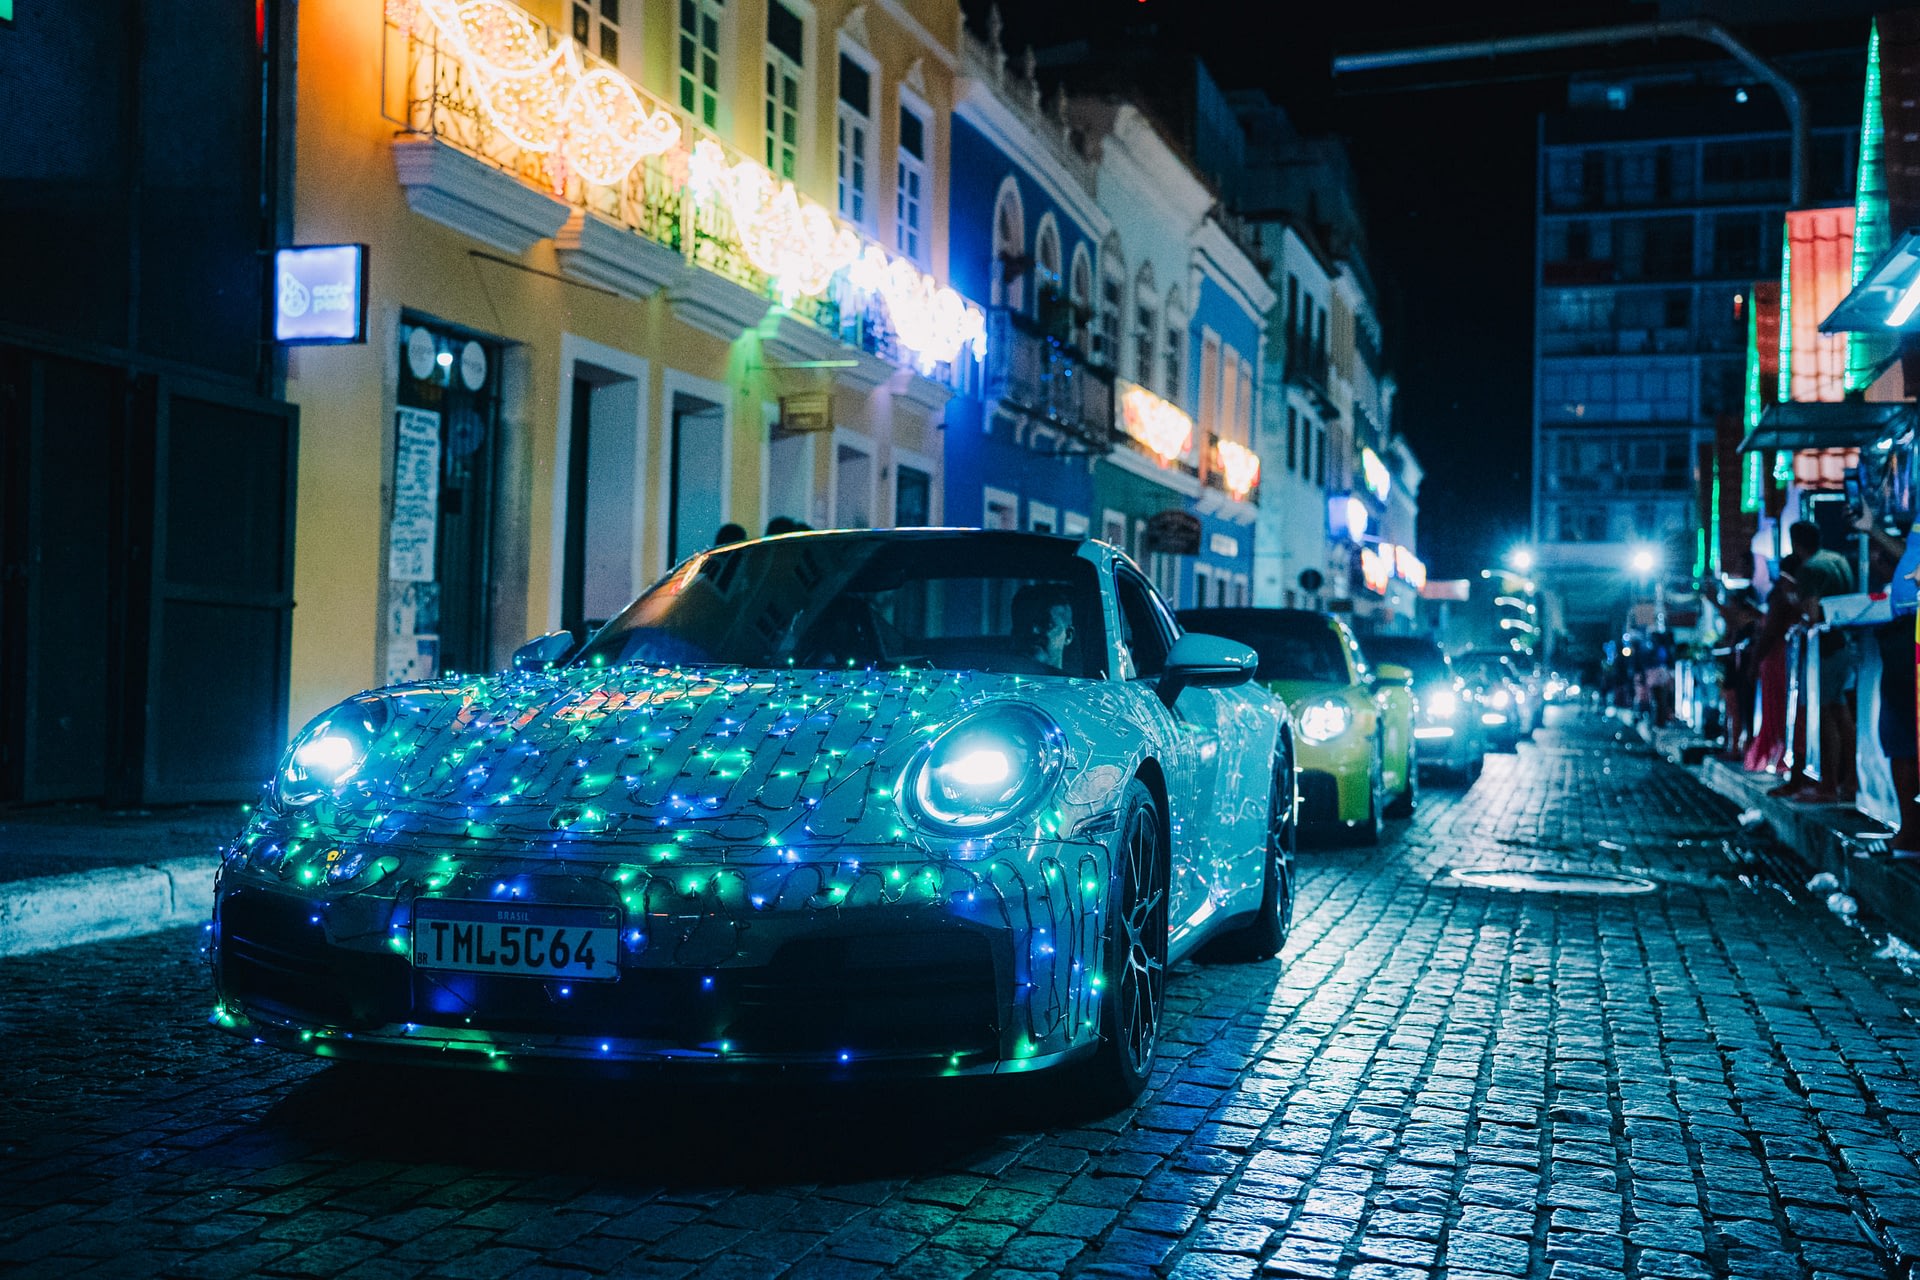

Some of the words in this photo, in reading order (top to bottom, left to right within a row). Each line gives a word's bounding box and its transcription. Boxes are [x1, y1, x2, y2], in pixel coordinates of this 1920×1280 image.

[497, 911, 529, 922] BRASIL
[430, 922, 595, 970] TML5C64
[417, 952, 428, 965] BR
